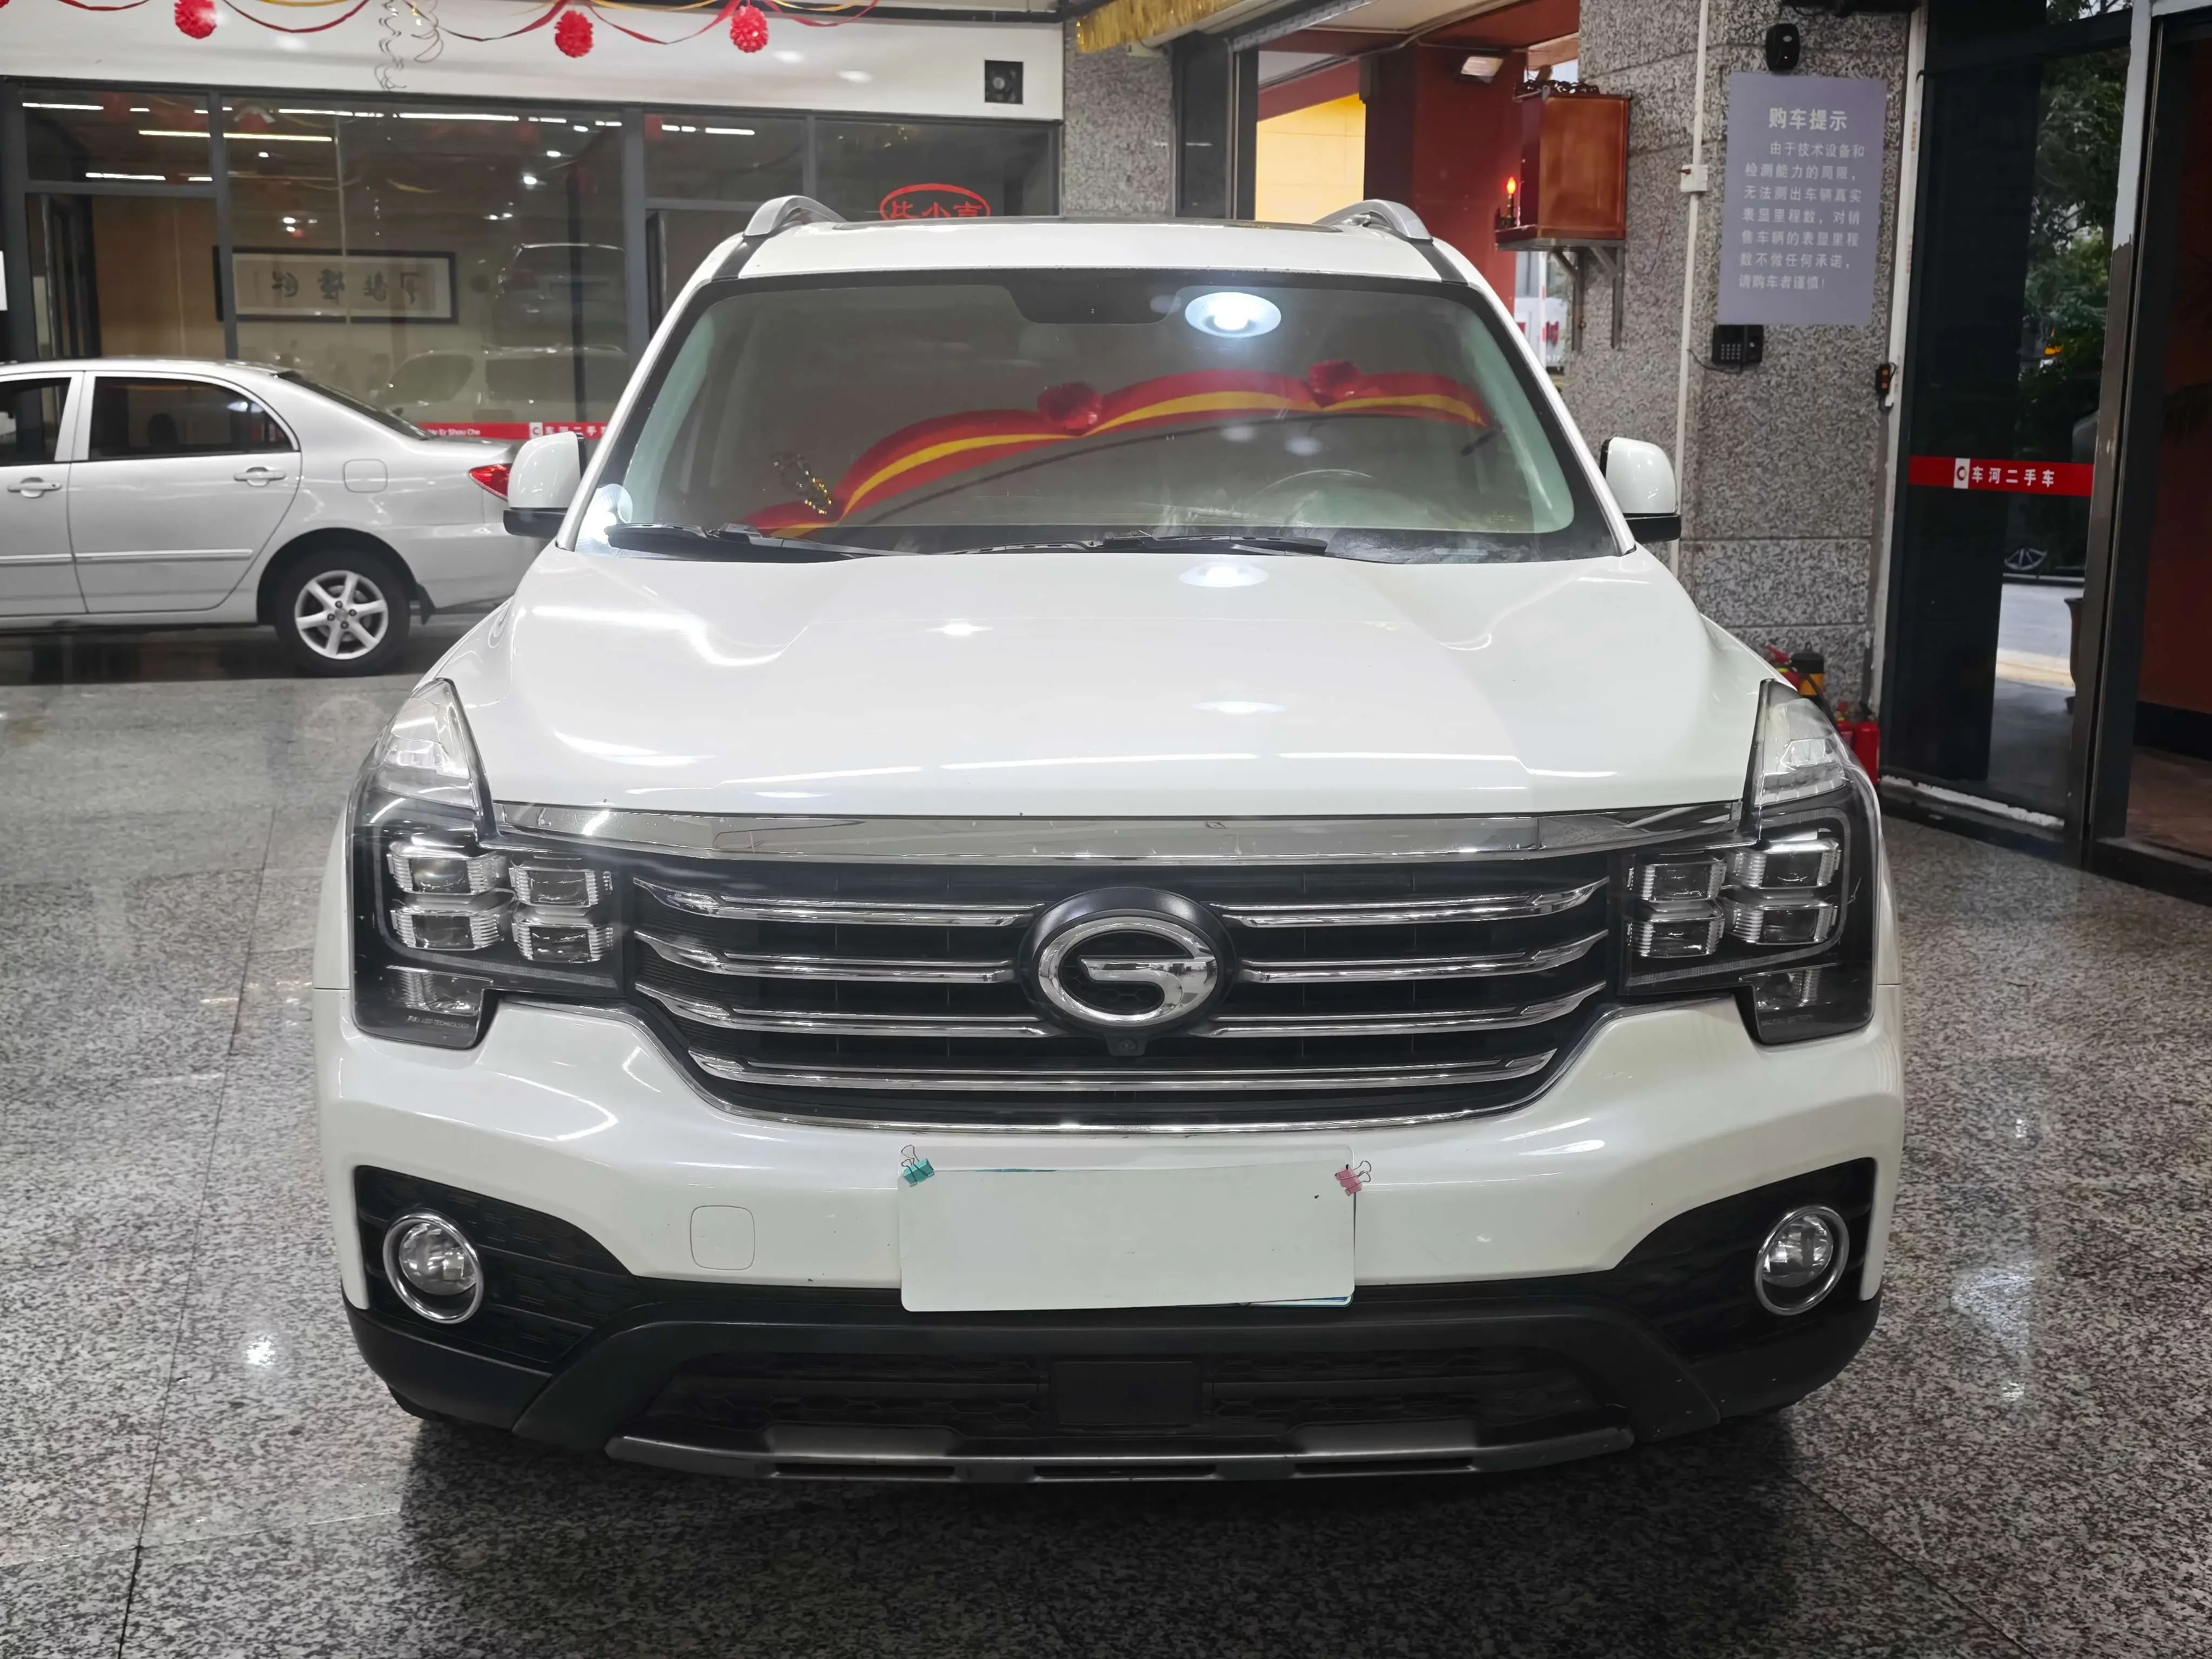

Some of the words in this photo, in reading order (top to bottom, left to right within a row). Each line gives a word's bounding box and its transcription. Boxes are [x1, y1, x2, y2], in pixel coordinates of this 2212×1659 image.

[1769, 107, 1847, 131] 购车提示
[1770, 141, 1864, 158] 由于技术设备和
[1745, 161, 1856, 181] 检测能力的局限，
[1743, 185, 1862, 203] 无法测出车辆真实
[1972, 466, 2054, 487] 车河二手车
